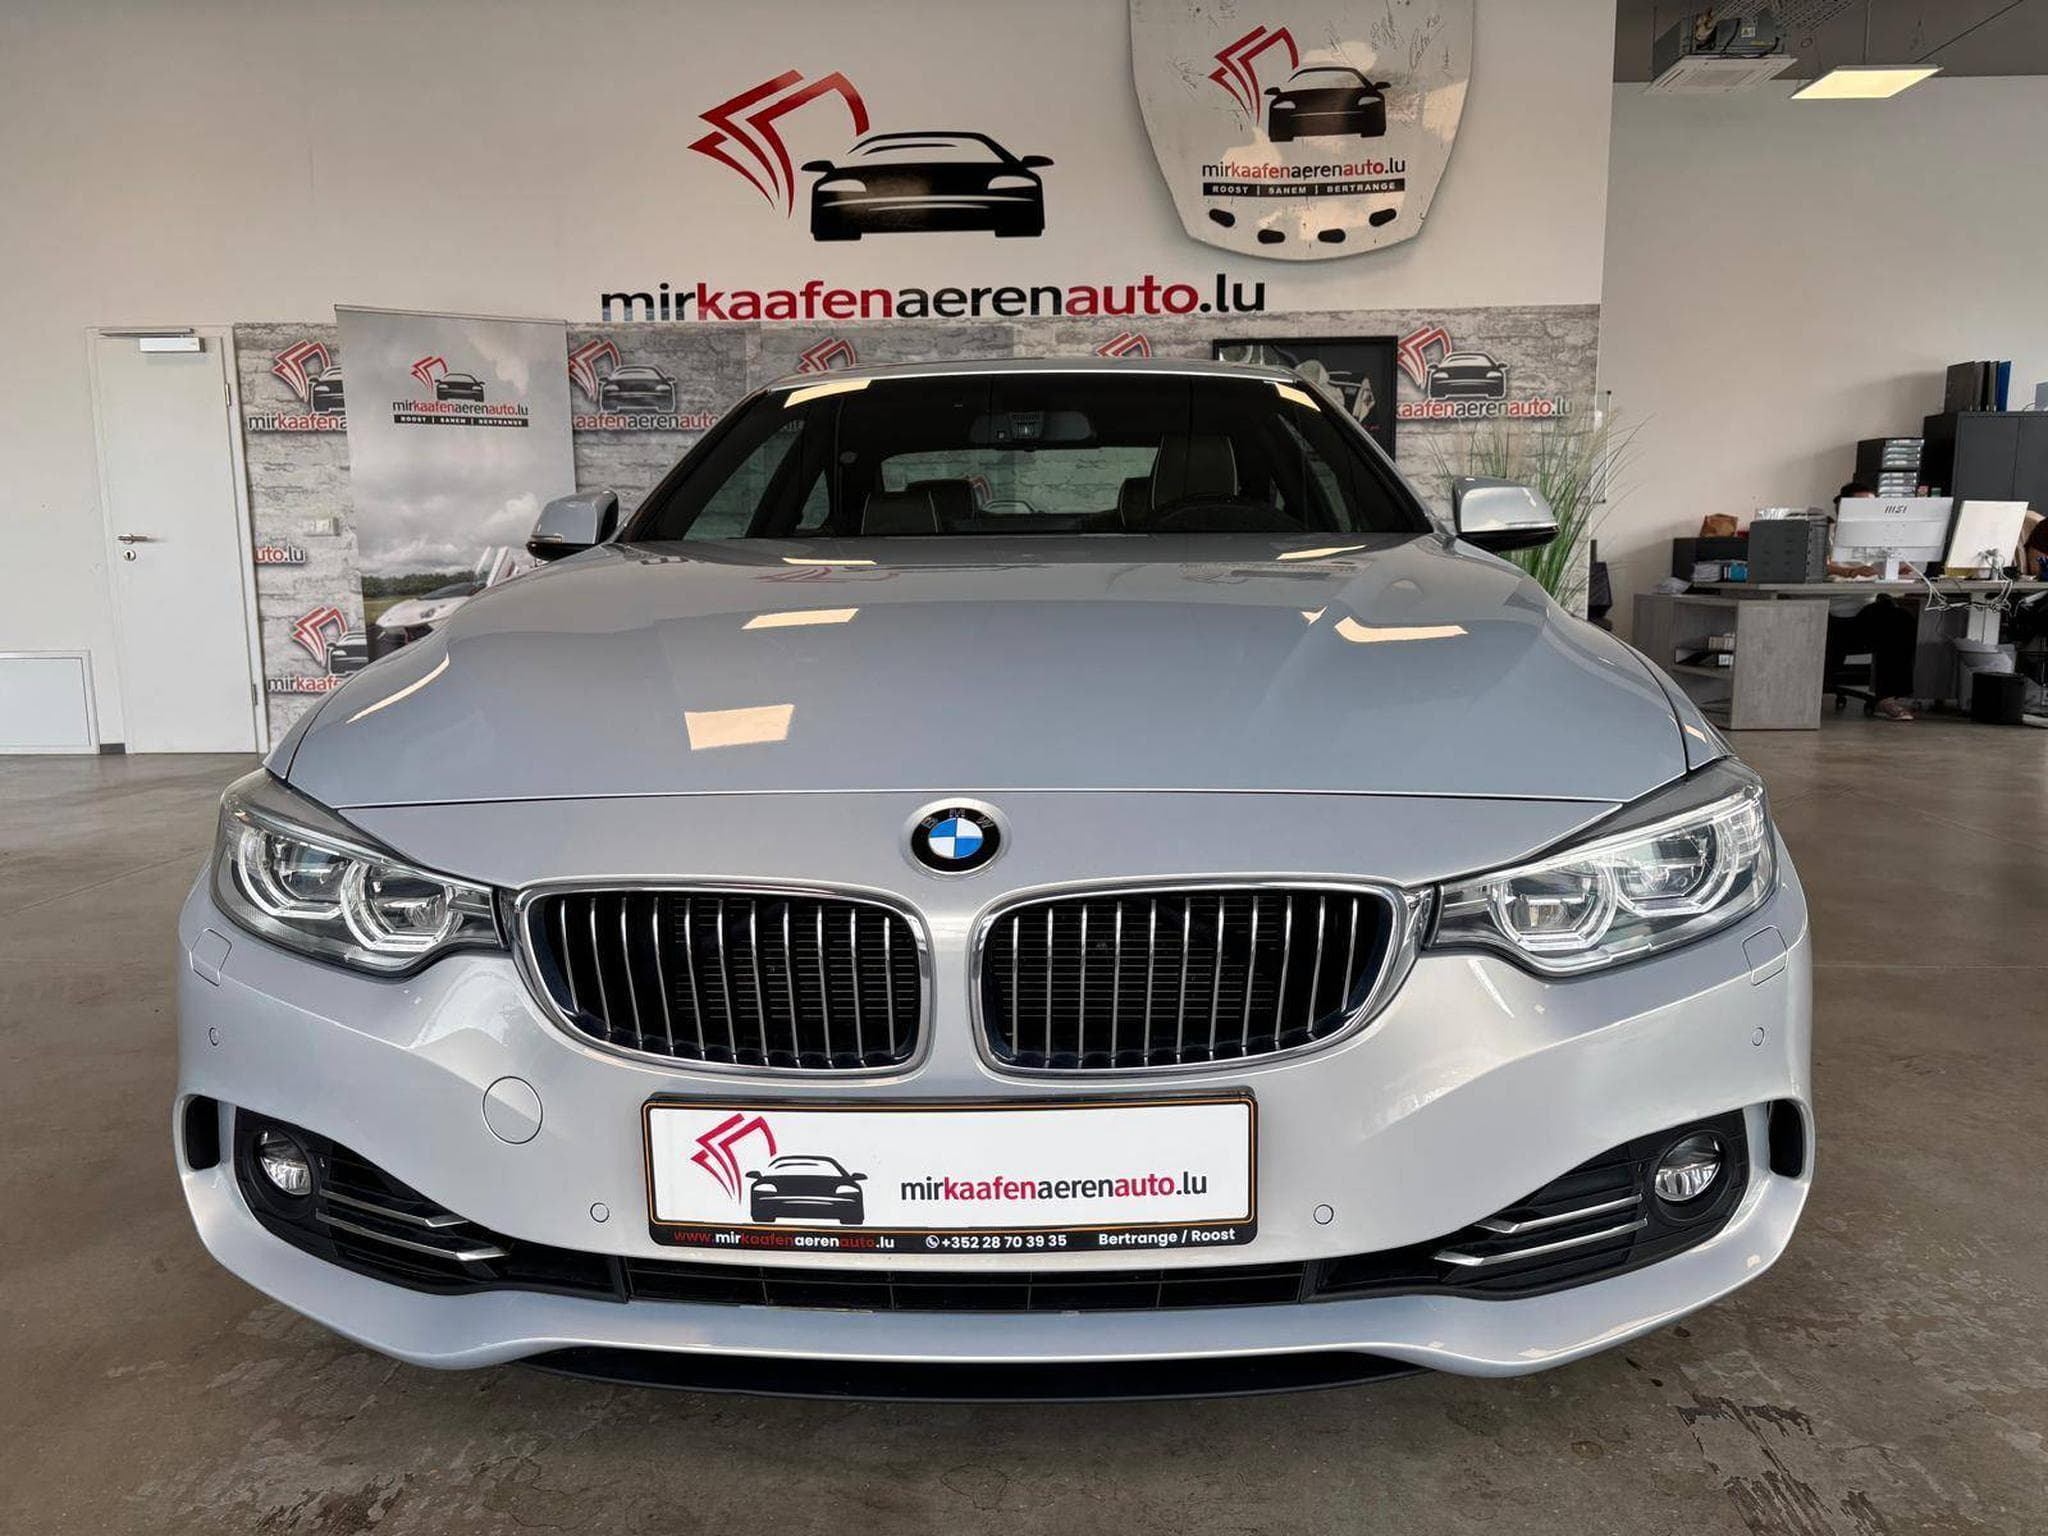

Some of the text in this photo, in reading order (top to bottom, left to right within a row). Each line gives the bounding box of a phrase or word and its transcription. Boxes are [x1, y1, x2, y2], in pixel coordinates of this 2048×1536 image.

[1202, 157, 1406, 179] mirkaafenaerenauto.lu
[1212, 185, 1249, 195] ROOST
[1268, 186, 1307, 195] SANEM
[1326, 182, 1396, 193] BERTRANGE
[601, 273, 1265, 322] mirkaafenaerenauto.lu
[392, 399, 529, 416] mirkaafenaerenauto.lu
[900, 1171, 1208, 1201] mirkaafenaerenauto.lu
[673, 1230, 895, 1249] www.mirkaafenaerenauto.lu
[941, 1235, 979, 1249] +352
[982, 1235, 1001, 1249] 28
[1004, 1235, 1023, 1249] 70
[1026, 1235, 1044, 1248] 39
[1048, 1234, 1067, 1247] 35
[1099, 1231, 1178, 1246] Bertrange
[1191, 1228, 1236, 1242] Roost
